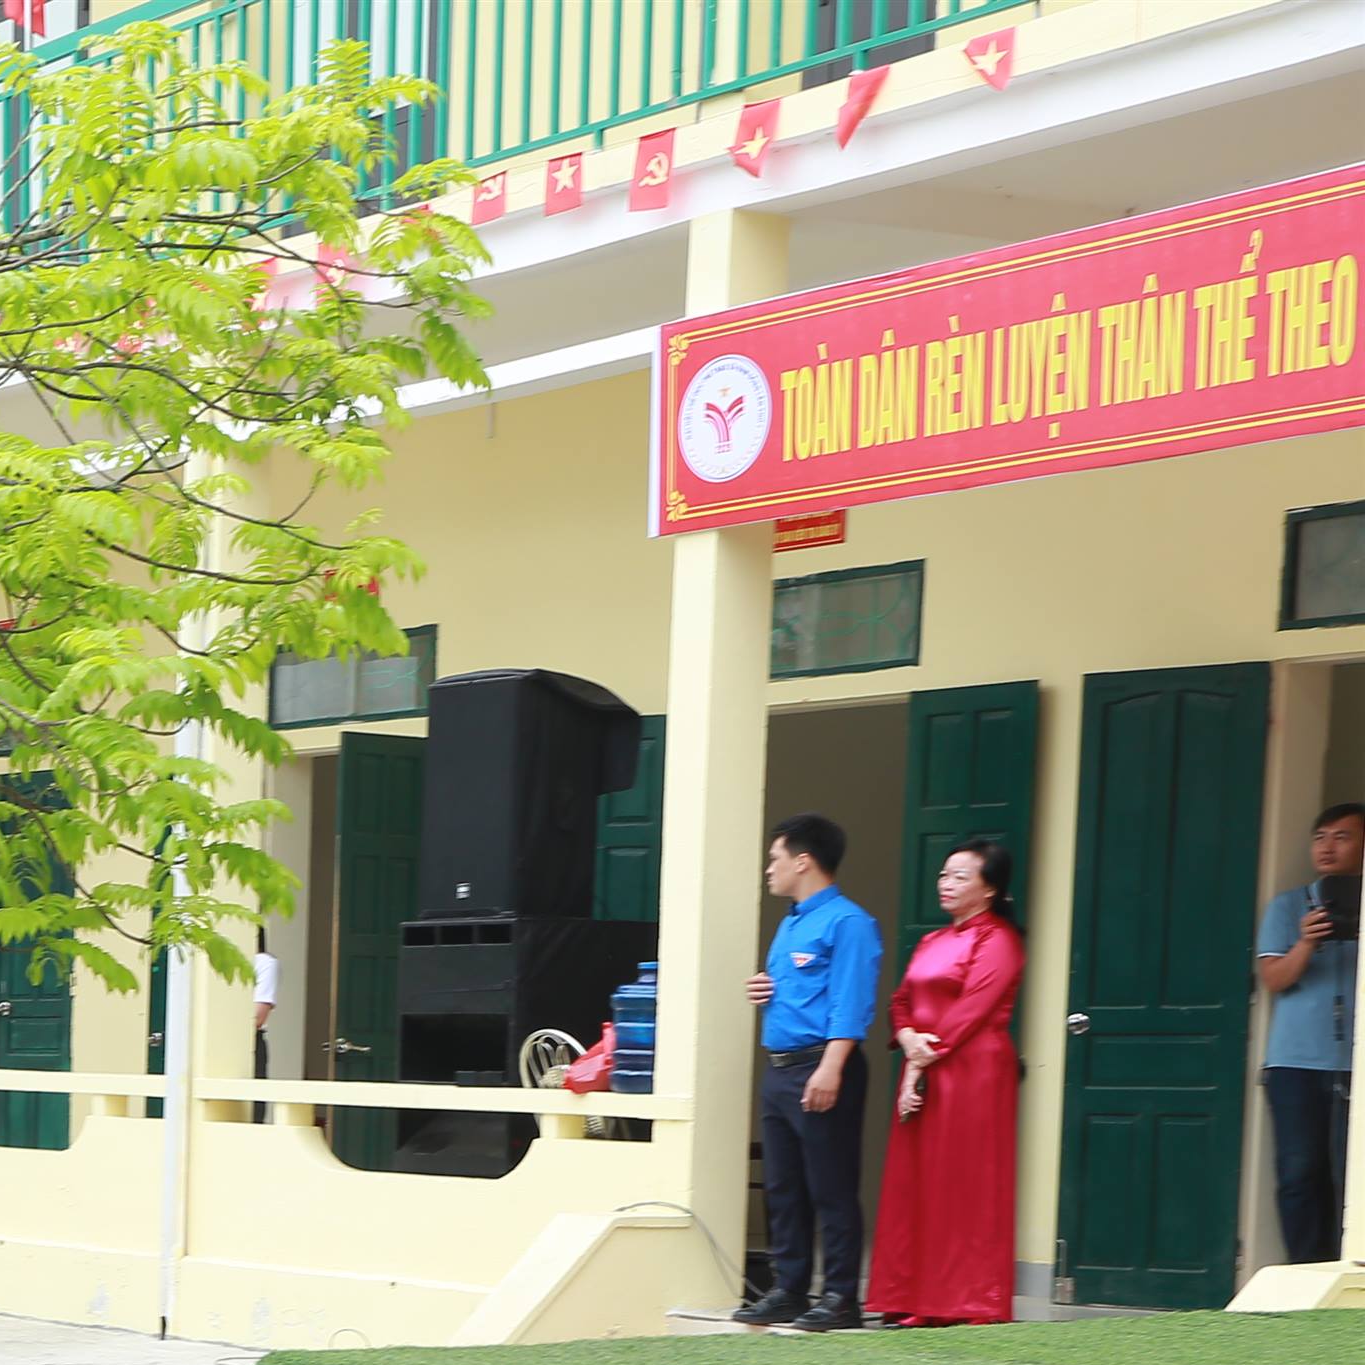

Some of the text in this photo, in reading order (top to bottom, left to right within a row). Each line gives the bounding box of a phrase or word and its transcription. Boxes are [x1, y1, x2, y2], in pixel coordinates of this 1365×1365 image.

[780, 342, 854, 462] TOÀN
[857, 329, 919, 449] DÂN
[923, 315, 986, 438] RÈN
[990, 292, 1091, 439] LUYỆN
[1098, 273, 1186, 407] THÂN
[1193, 228, 1263, 390] THỂ
[1265, 254, 1358, 377] THEO
